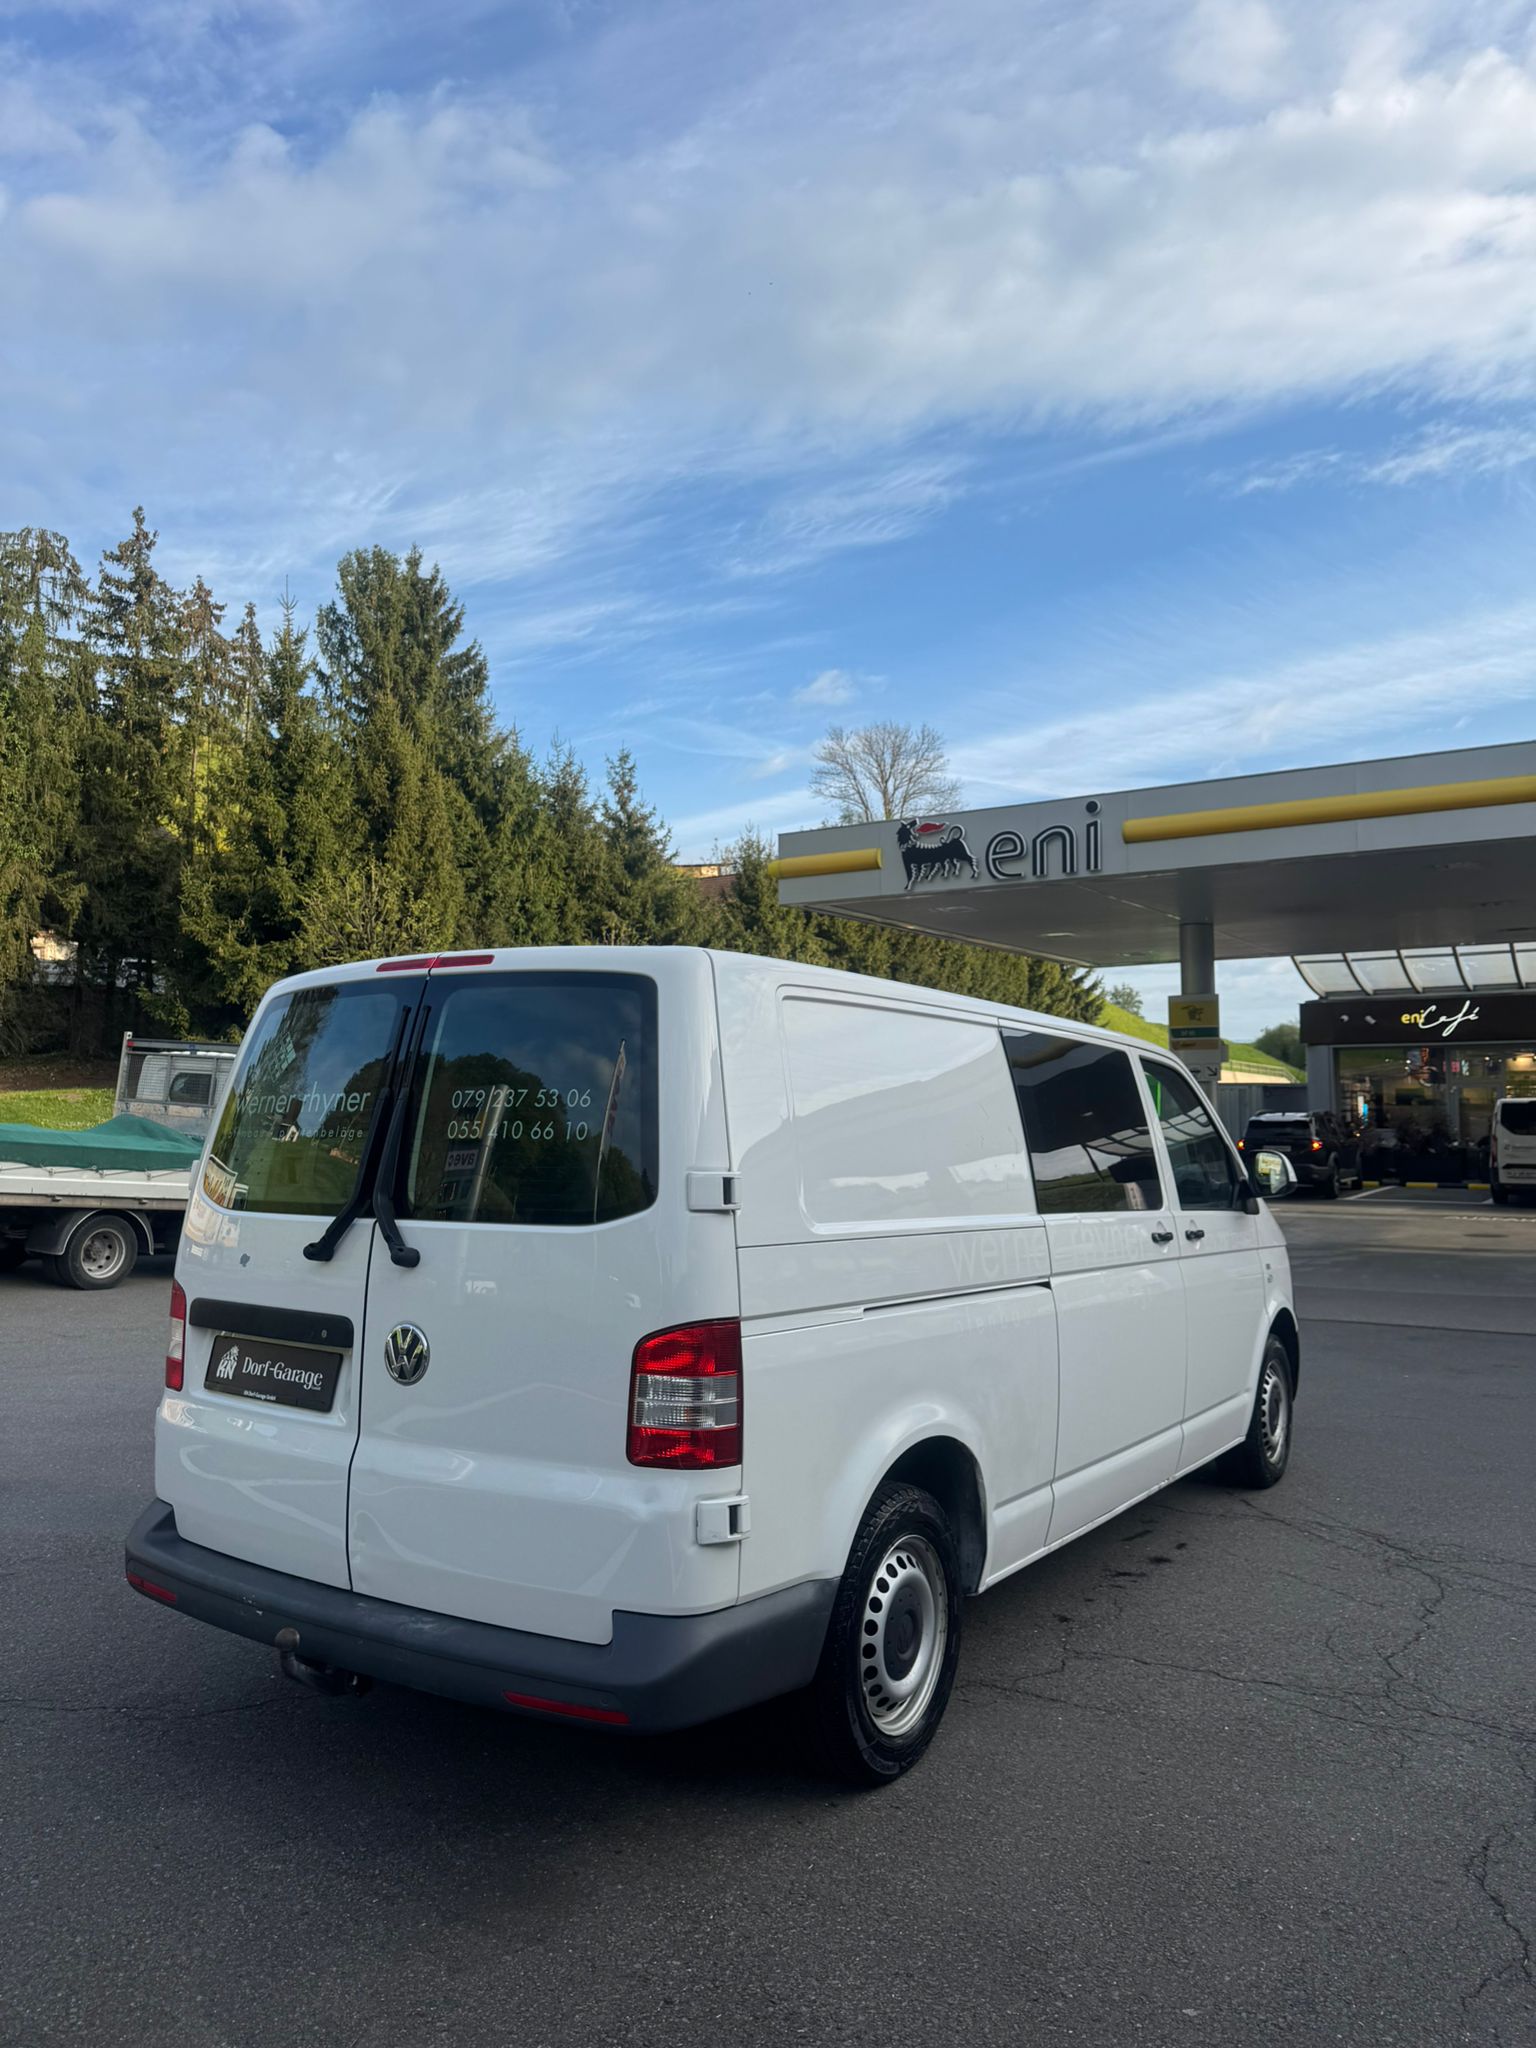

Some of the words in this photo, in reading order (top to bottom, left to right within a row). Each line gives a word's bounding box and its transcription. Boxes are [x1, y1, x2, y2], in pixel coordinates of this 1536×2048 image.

[986, 799, 1103, 880] eni
[237, 1093, 297, 1115] werner
[301, 1081, 372, 1123] rhyner
[451, 1089, 486, 1109] 079
[491, 1088, 528, 1108] 237
[534, 1088, 560, 1108] 53
[566, 1088, 592, 1108] 06
[447, 1120, 481, 1140] 055
[488, 1120, 523, 1140] 410
[530, 1120, 555, 1140] 66
[564, 1121, 589, 1143] 10
[242, 1356, 323, 1390] Dorf-Garage
